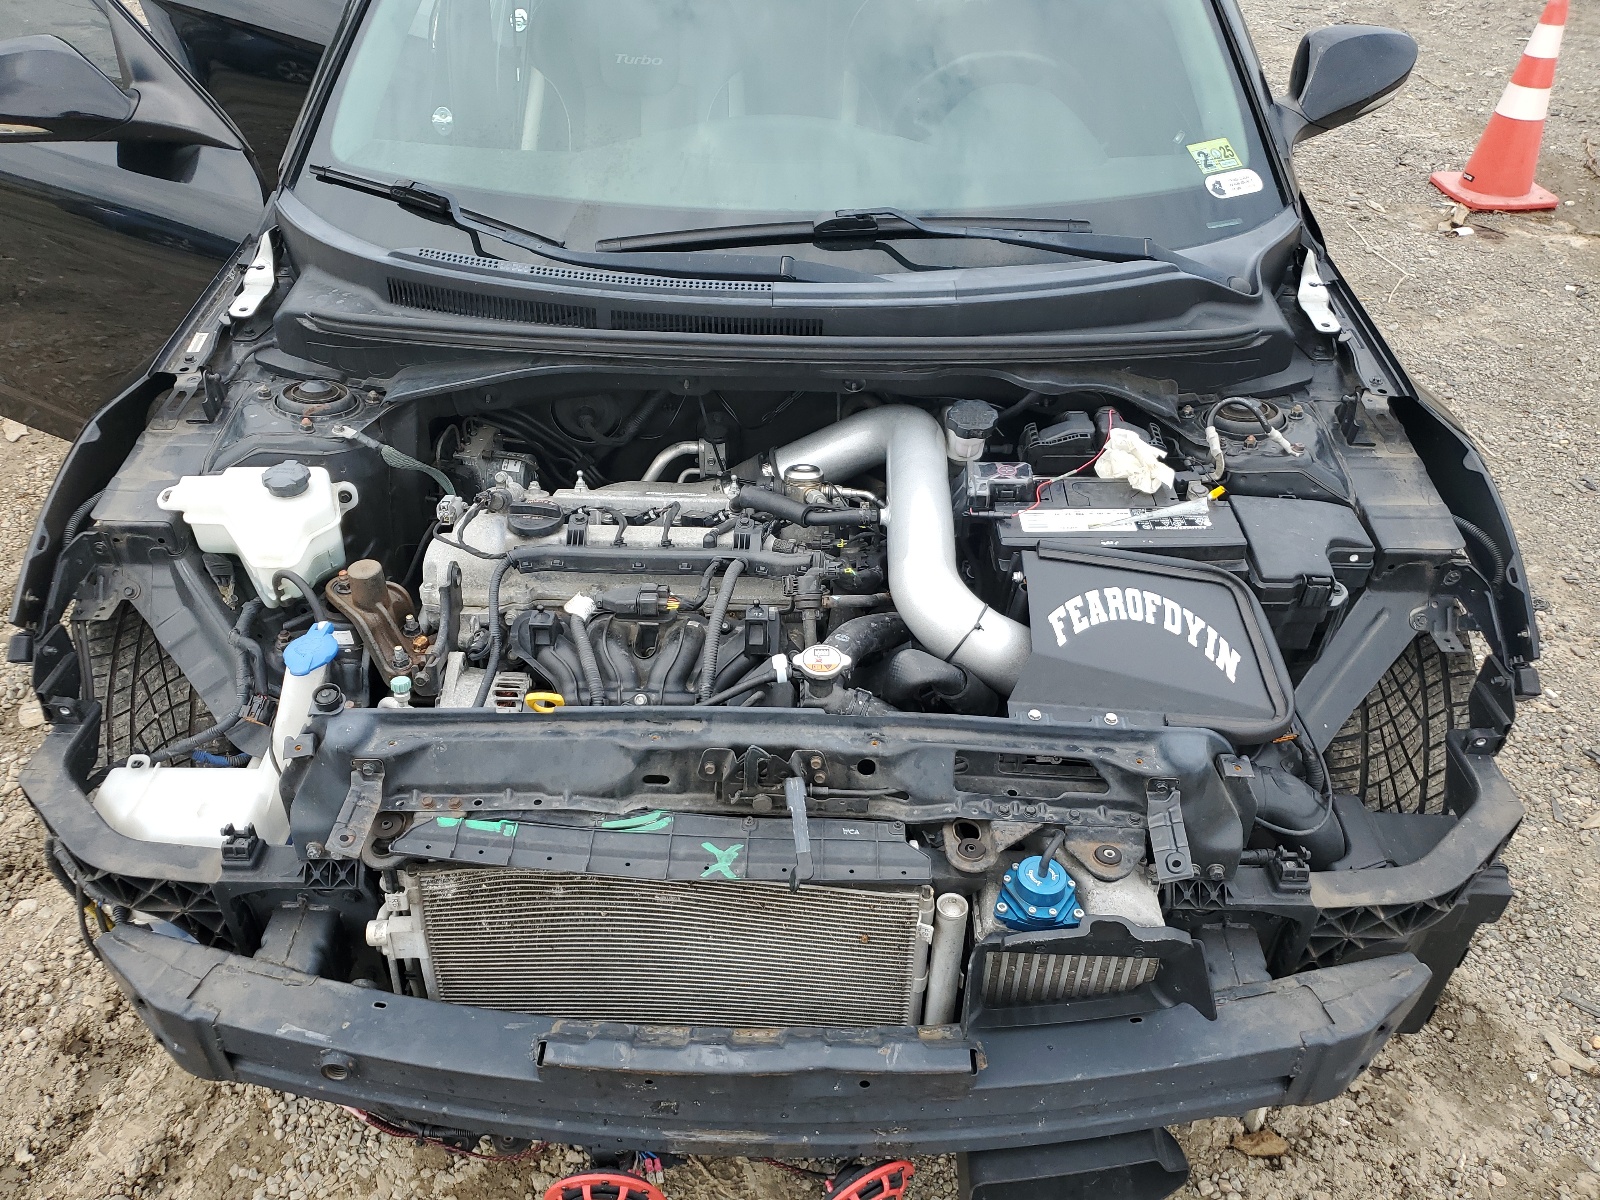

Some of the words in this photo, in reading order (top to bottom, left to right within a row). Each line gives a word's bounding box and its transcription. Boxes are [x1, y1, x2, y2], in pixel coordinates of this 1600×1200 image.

[615, 53, 663, 65] Turbo
[1197, 151, 1213, 168] 2
[1219, 145, 1234, 158] 25
[1047, 586, 1241, 684] FEAROFDYIN
